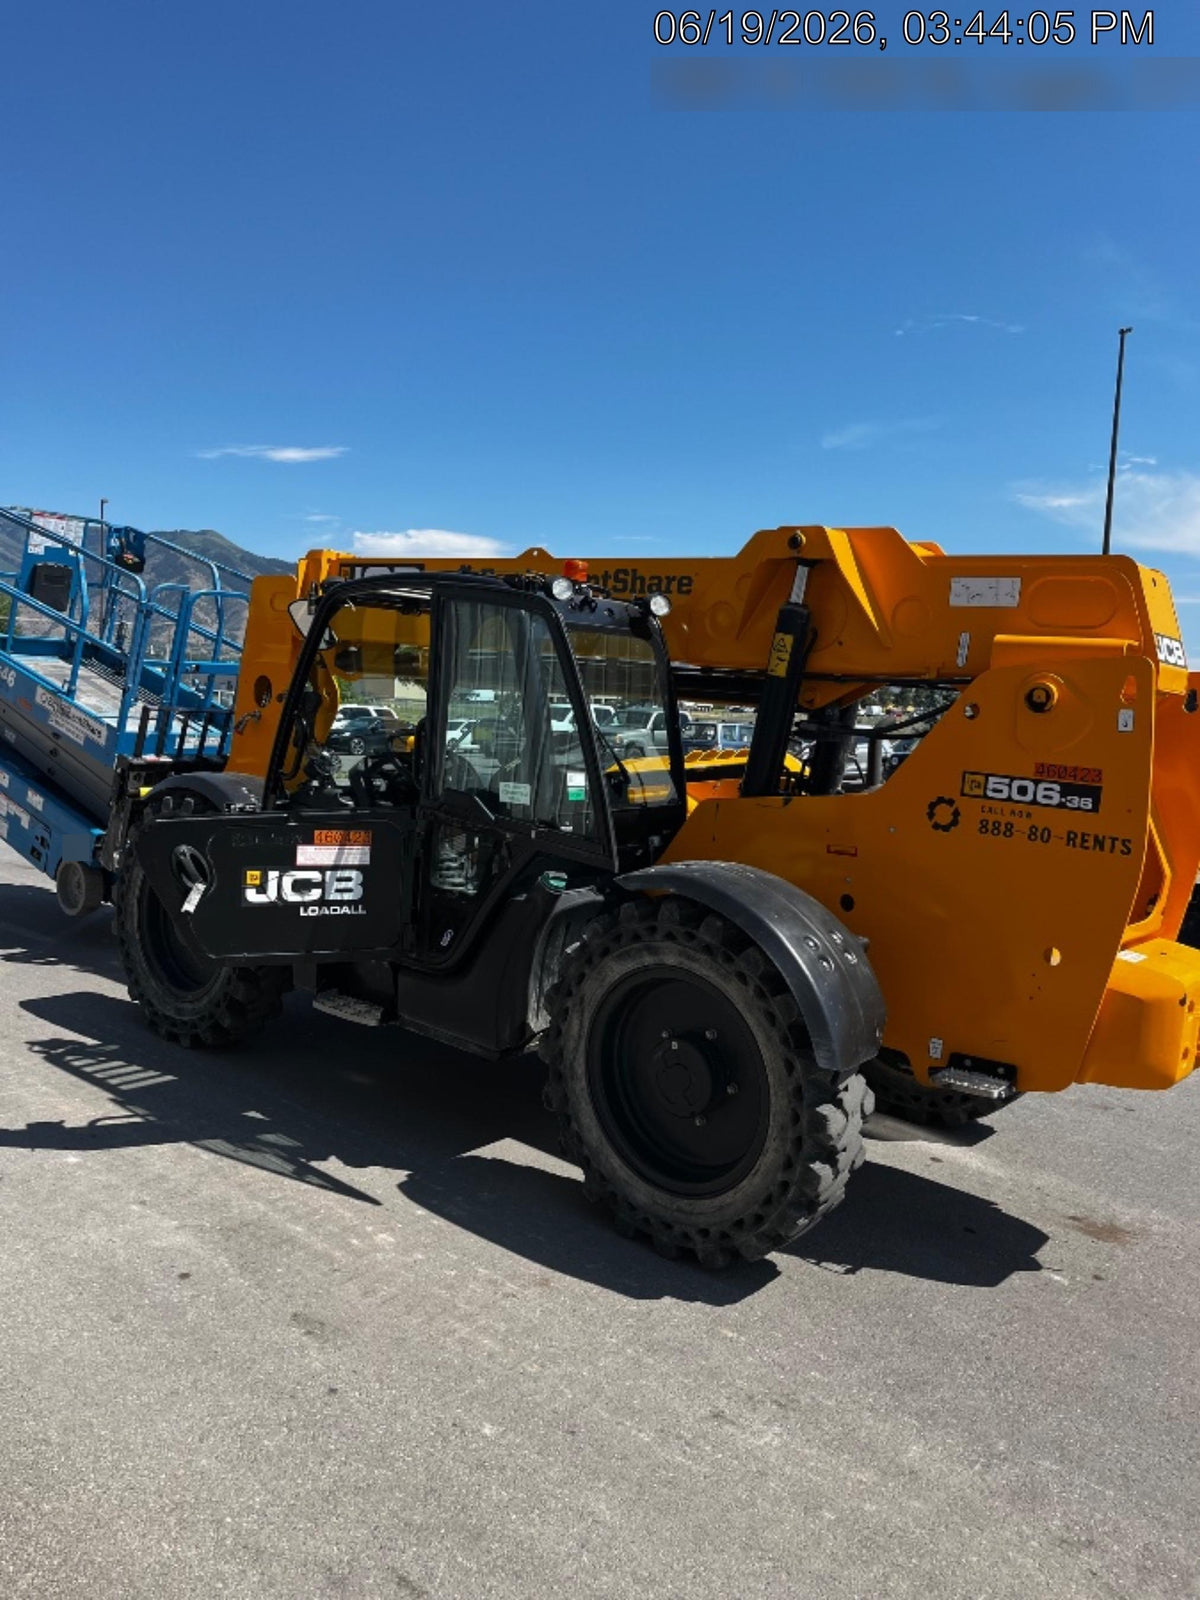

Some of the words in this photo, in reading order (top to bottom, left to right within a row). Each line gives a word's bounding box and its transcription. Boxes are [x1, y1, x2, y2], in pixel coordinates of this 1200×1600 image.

[1157, 636, 1185, 666] JCB
[1036, 763, 1102, 782] 460423
[978, 819, 1132, 856] 888-80-RENTS
[245, 870, 363, 903] JCB
[299, 905, 367, 916] LOADALL
